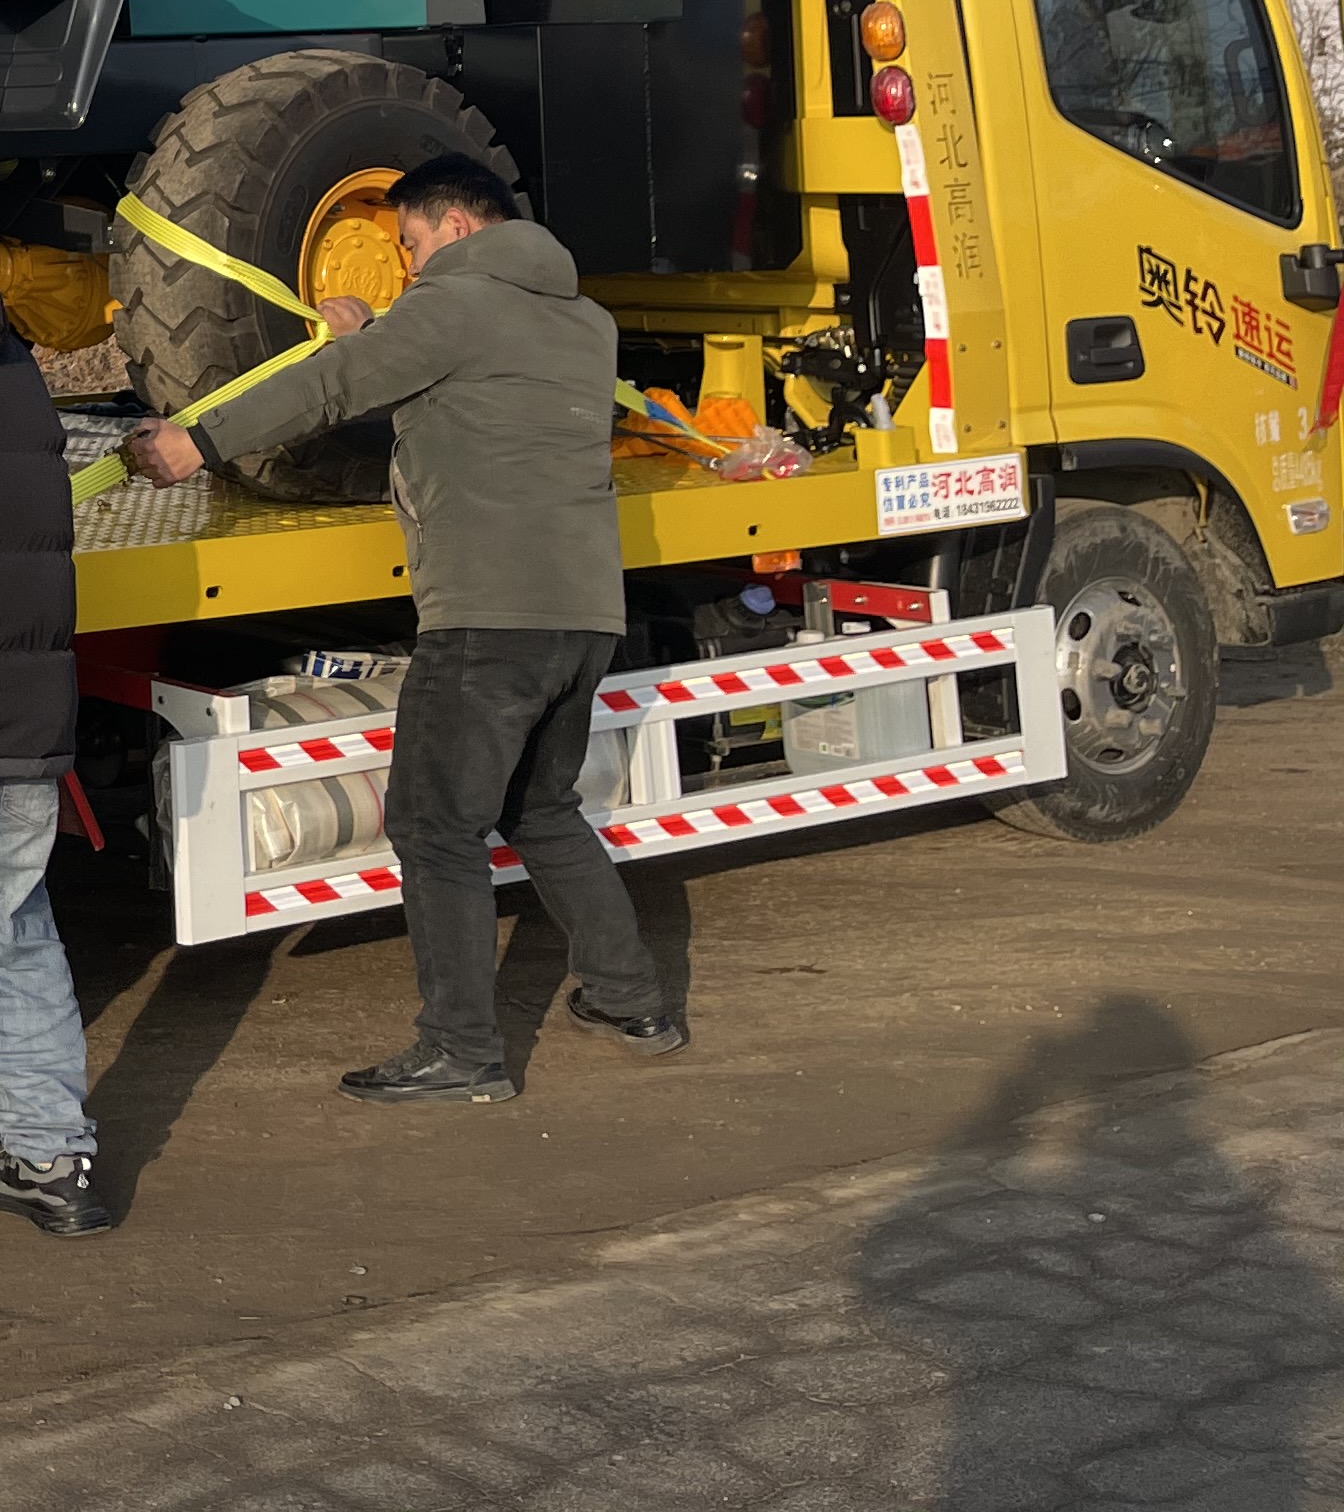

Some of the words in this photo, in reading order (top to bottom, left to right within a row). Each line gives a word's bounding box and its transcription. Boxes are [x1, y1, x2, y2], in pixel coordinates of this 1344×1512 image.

[927, 71, 984, 281] 河北高润
[1137, 244, 1226, 346] 奥铃
[1231, 294, 1296, 373] 速运
[883, 471, 929, 492] 专利产品
[931, 463, 1019, 500] 河北高润
